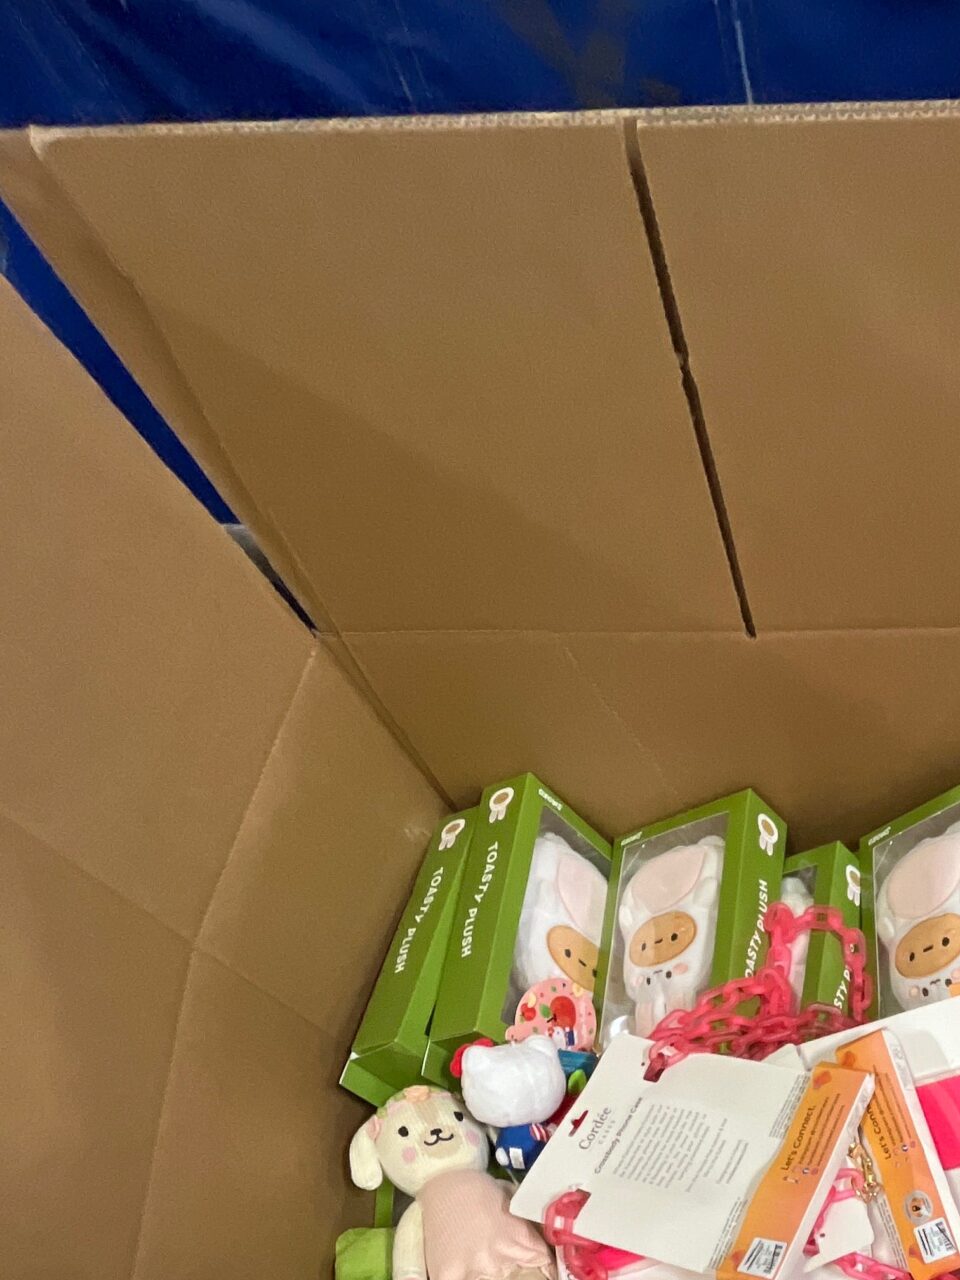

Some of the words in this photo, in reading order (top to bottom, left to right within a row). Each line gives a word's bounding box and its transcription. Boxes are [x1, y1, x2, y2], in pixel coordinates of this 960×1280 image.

[414, 866, 444, 924] TOASTY
[473, 841, 499, 903] TOASTY
[394, 927, 417, 974] PLUSH
[461, 907, 479, 958] PLUSH
[744, 930, 762, 979] OASTY
[578, 1105, 613, 1151] Cordée
[780, 1147, 799, 1172] Let's
